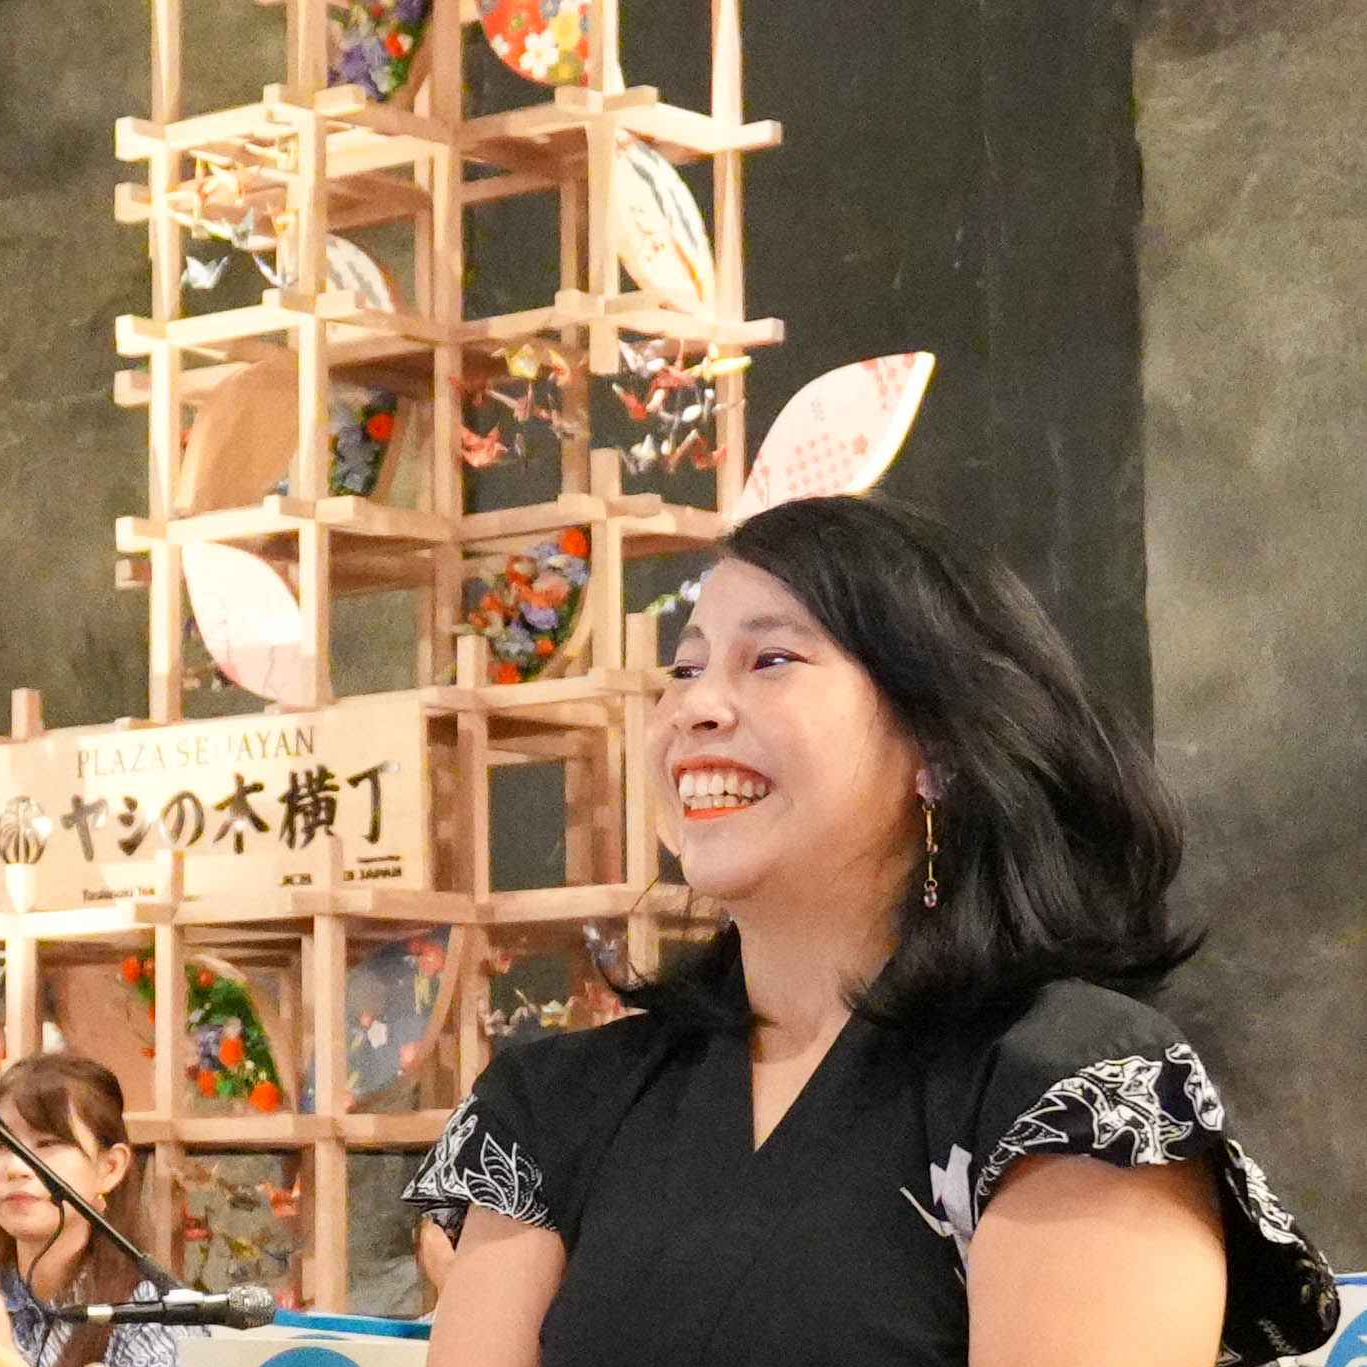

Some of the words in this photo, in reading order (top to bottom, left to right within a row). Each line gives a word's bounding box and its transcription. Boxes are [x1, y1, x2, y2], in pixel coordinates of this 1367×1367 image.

[76, 743, 168, 779] PLAZA
[60, 761, 400, 862] ヤシの木横丁
